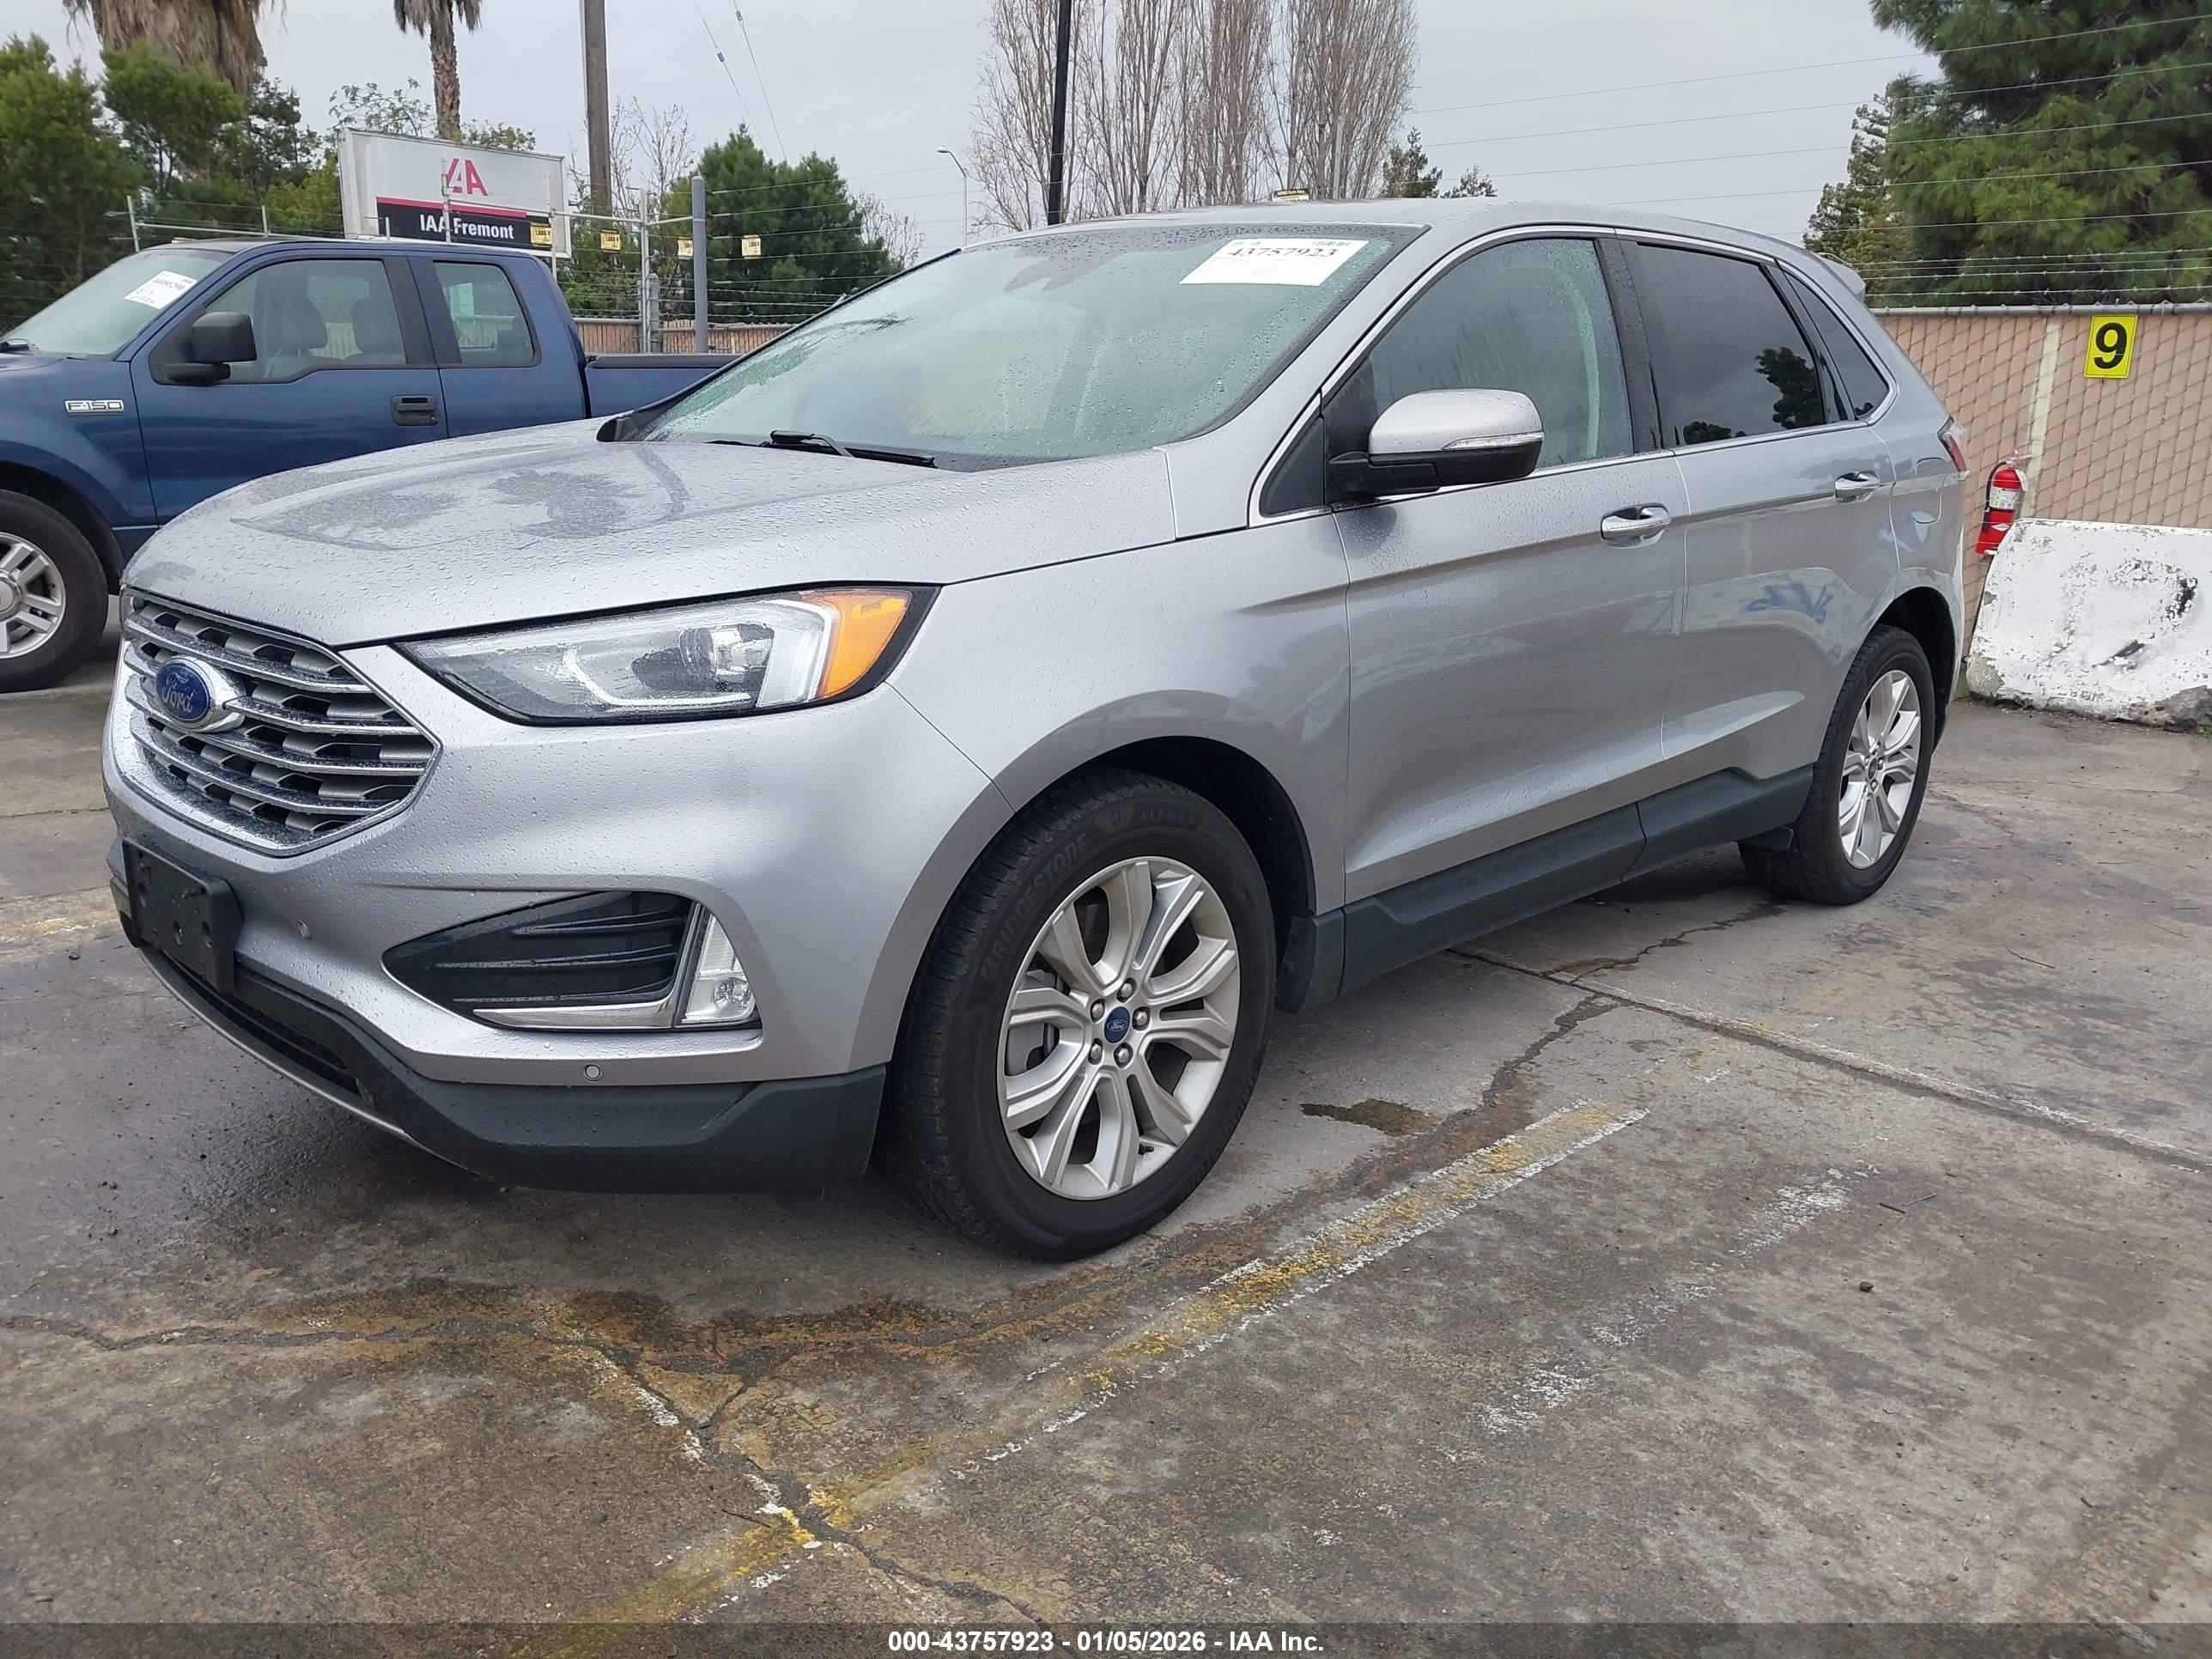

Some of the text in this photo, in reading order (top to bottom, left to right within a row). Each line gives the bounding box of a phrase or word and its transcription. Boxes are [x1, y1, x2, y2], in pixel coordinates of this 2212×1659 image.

[453, 217, 514, 240] Fremont
[1228, 247, 1338, 258] 43757923
[2094, 322, 2127, 369] 9
[161, 672, 195, 714] Ford
[981, 832, 1094, 981] BRIDGESTONE
